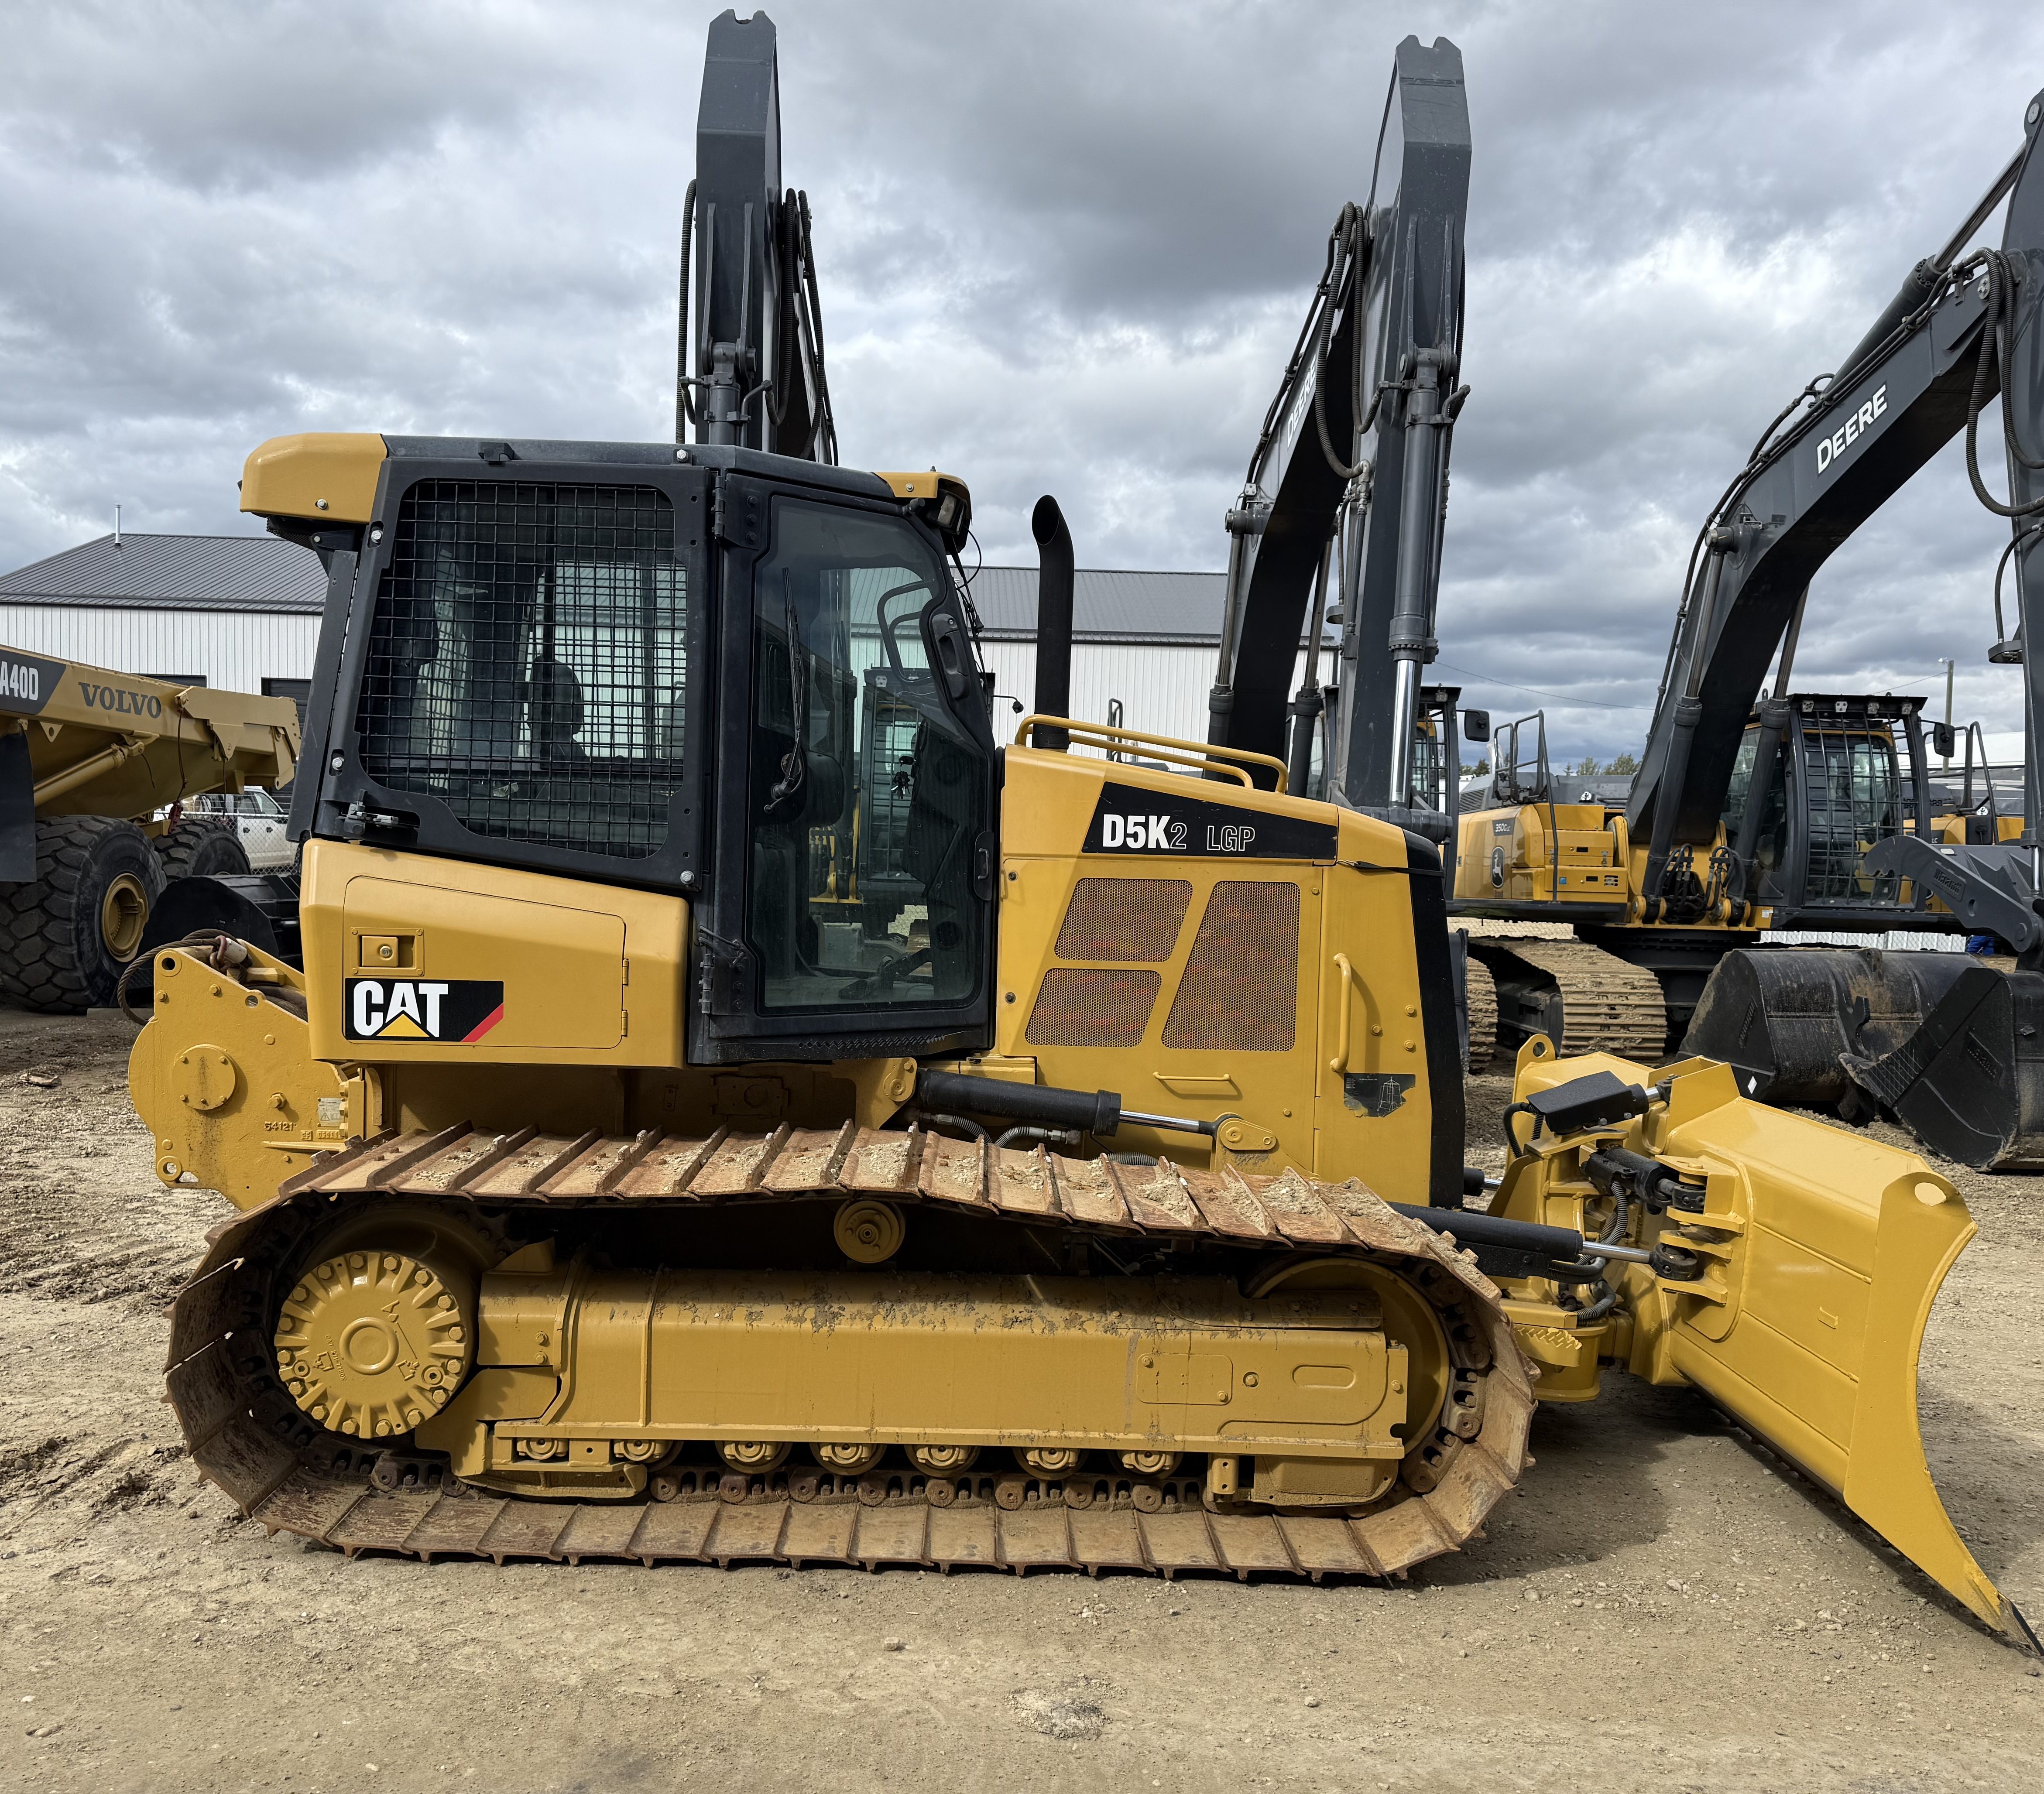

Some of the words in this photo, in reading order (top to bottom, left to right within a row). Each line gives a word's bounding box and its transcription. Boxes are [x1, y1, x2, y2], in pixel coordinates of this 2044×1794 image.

[1287, 353, 1316, 448] DEERE
[1817, 384, 1887, 474] DEERE
[0, 661, 39, 701] A40D
[78, 681, 161, 719] VOLVO
[1207, 825, 1255, 851] LGP
[353, 980, 449, 1037] CAT
